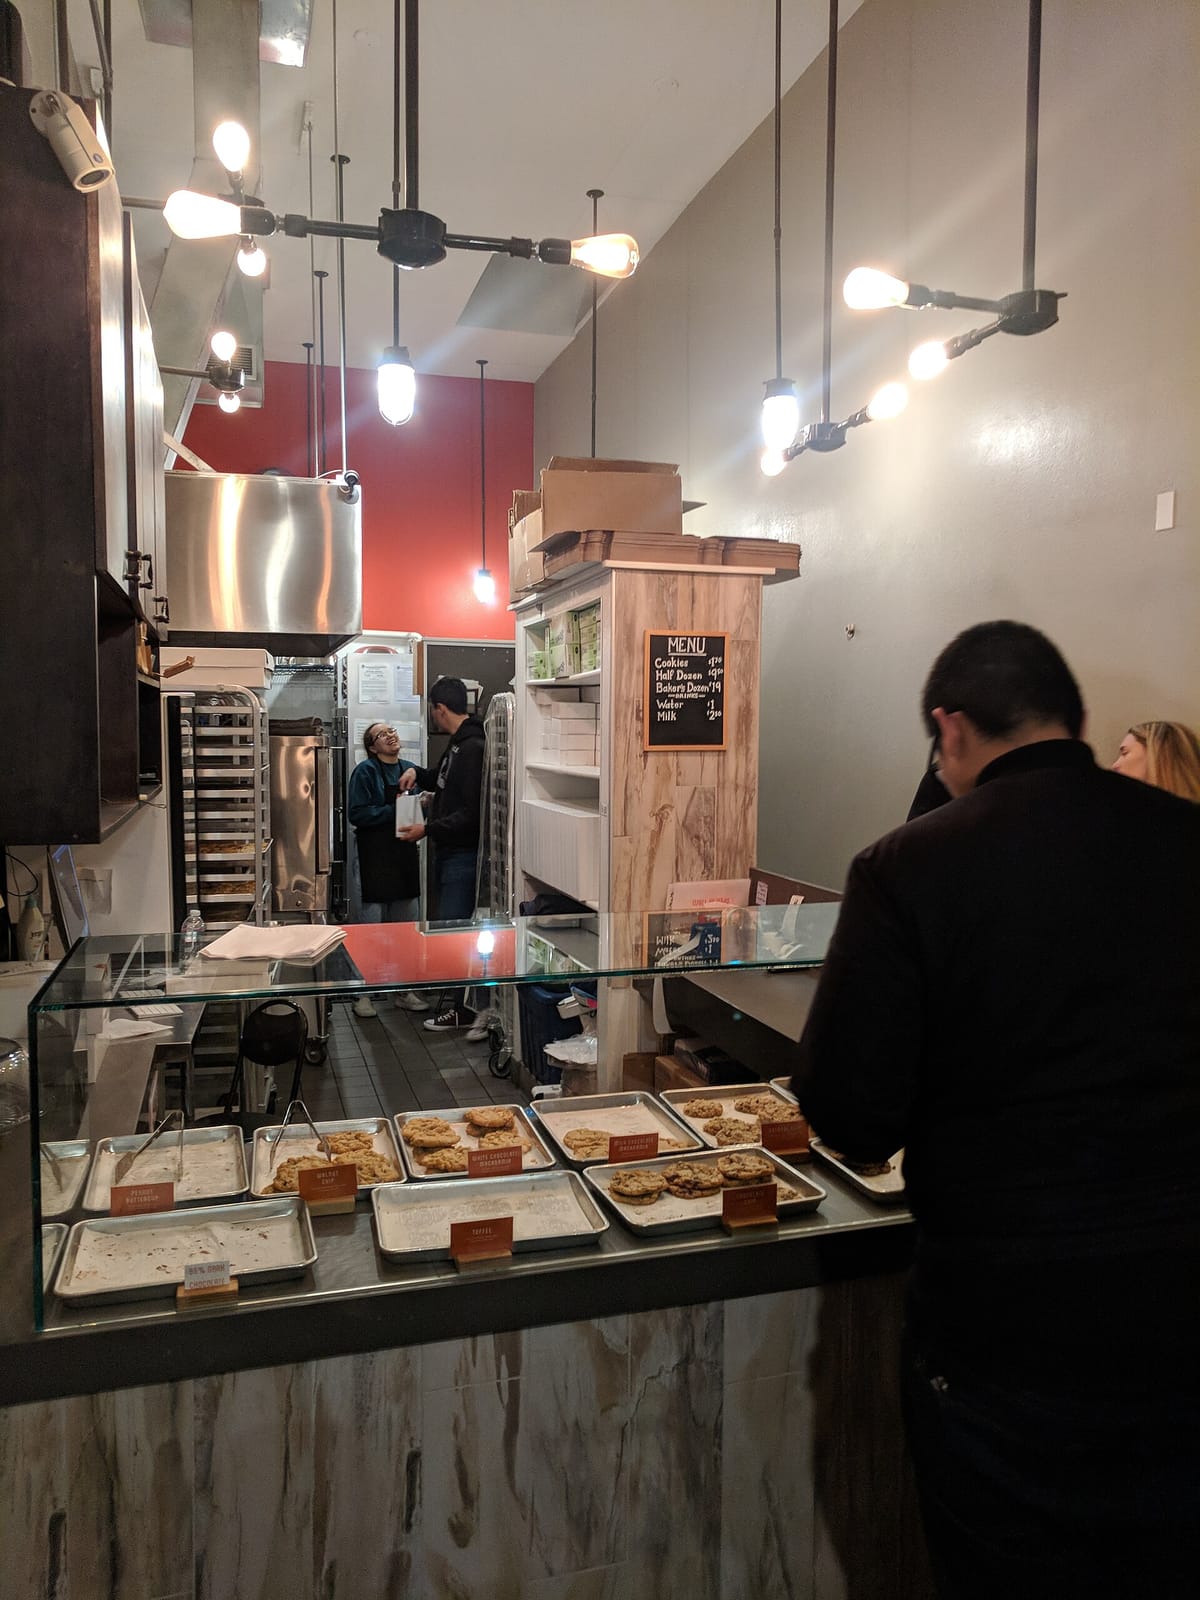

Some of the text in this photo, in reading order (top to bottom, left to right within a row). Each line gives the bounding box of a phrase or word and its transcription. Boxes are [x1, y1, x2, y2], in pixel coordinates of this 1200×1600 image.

[668, 637, 706, 653] MENU
[654, 657, 689, 668] Cookies
[655, 669, 675, 681] Half
[676, 669, 703, 681] Dozen
[656, 682, 686, 693] Baker's
[686, 682, 710, 693] Dozen
[656, 699, 684, 709] Water
[657, 711, 677, 722] Milk
